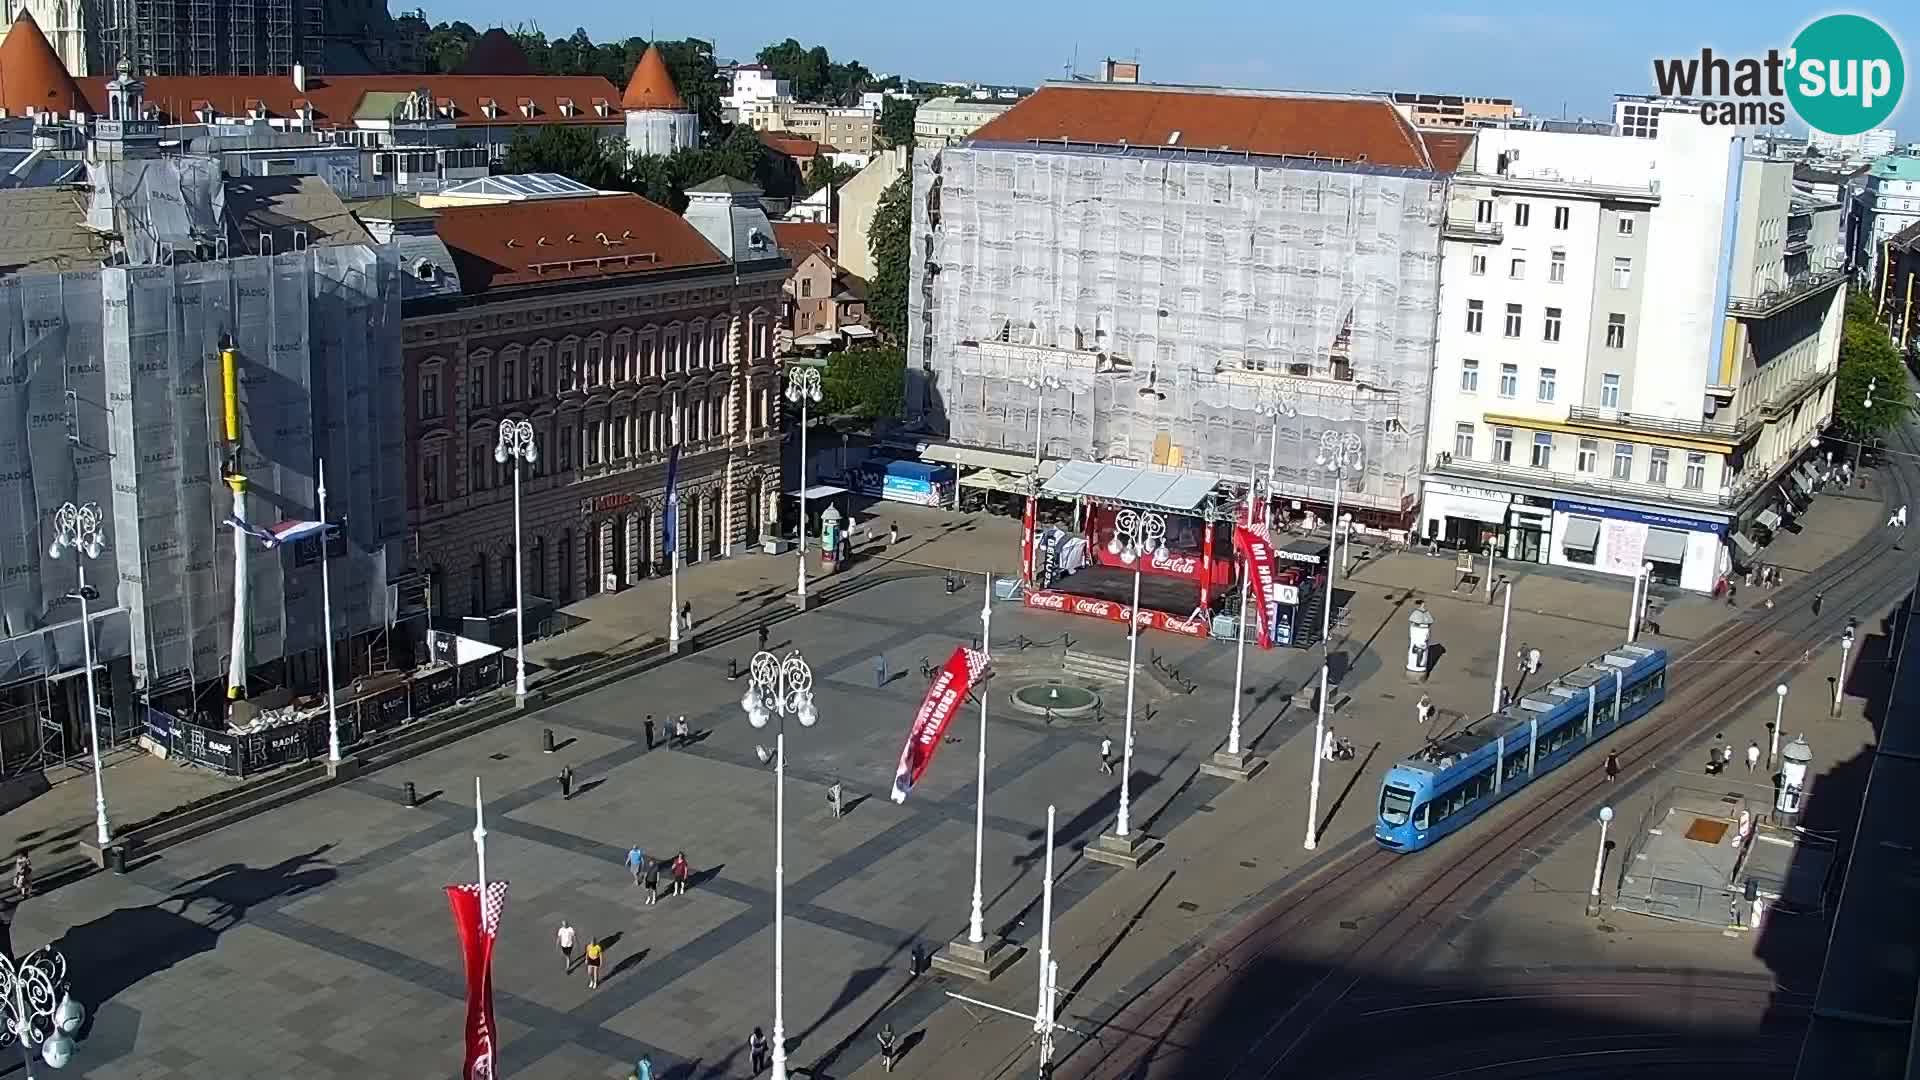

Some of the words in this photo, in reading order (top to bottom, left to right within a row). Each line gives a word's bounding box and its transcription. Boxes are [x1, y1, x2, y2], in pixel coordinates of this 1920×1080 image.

[1251, 543, 1267, 560] MI
[1031, 593, 1065, 608] Coca-Cola
[1076, 599, 1109, 616] Coca-Cola
[931, 671, 954, 698] FANS
[919, 688, 957, 745] CROATIAN
